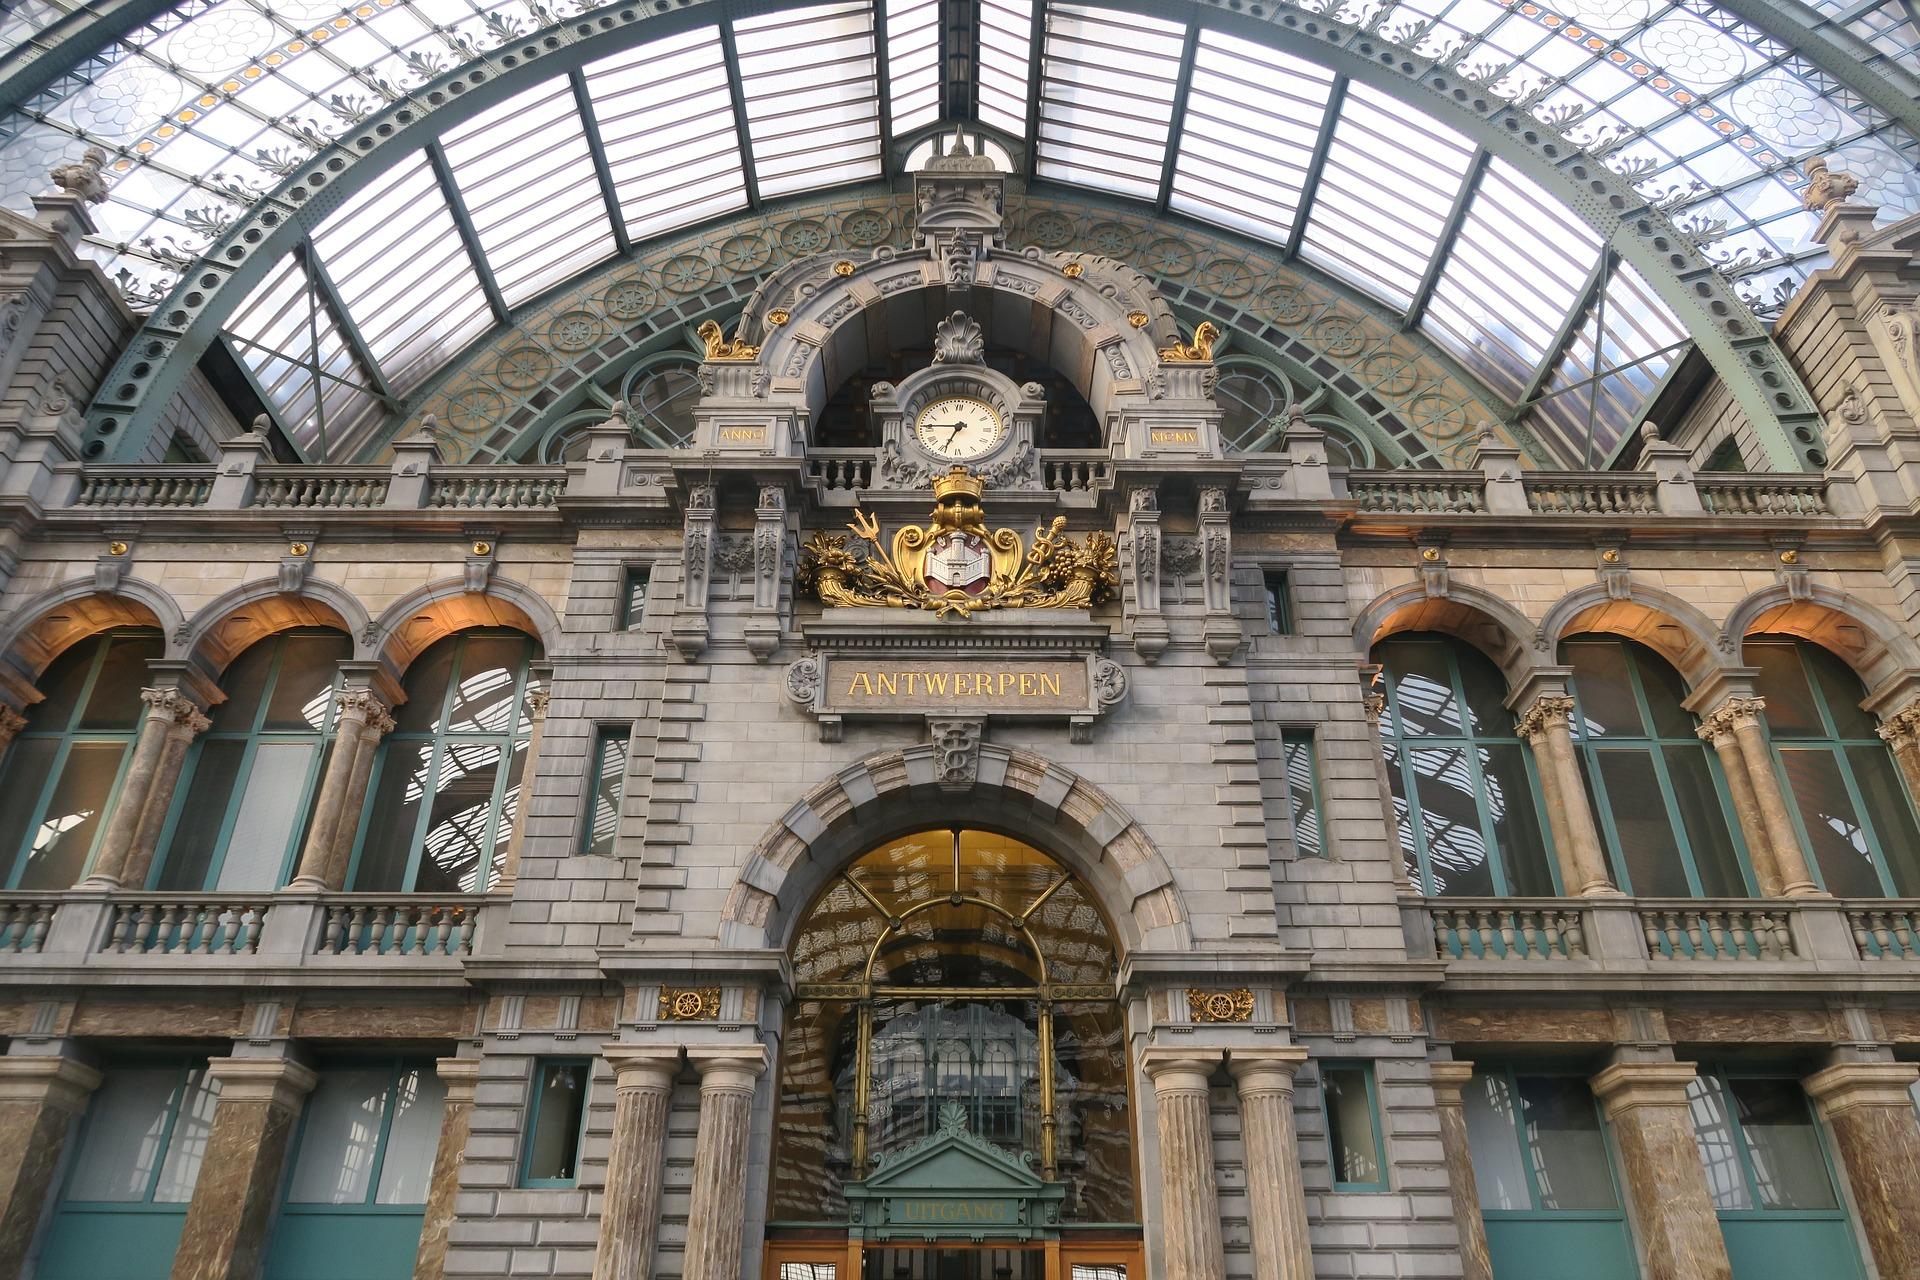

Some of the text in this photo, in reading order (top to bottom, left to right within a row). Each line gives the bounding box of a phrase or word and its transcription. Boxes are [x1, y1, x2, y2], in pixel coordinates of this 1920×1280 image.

[721, 430, 764, 440] ANNO
[1151, 432, 1197, 442] MCMV
[847, 672, 1061, 696] ANTWERPEN
[904, 1201, 1006, 1220] UITGANG
